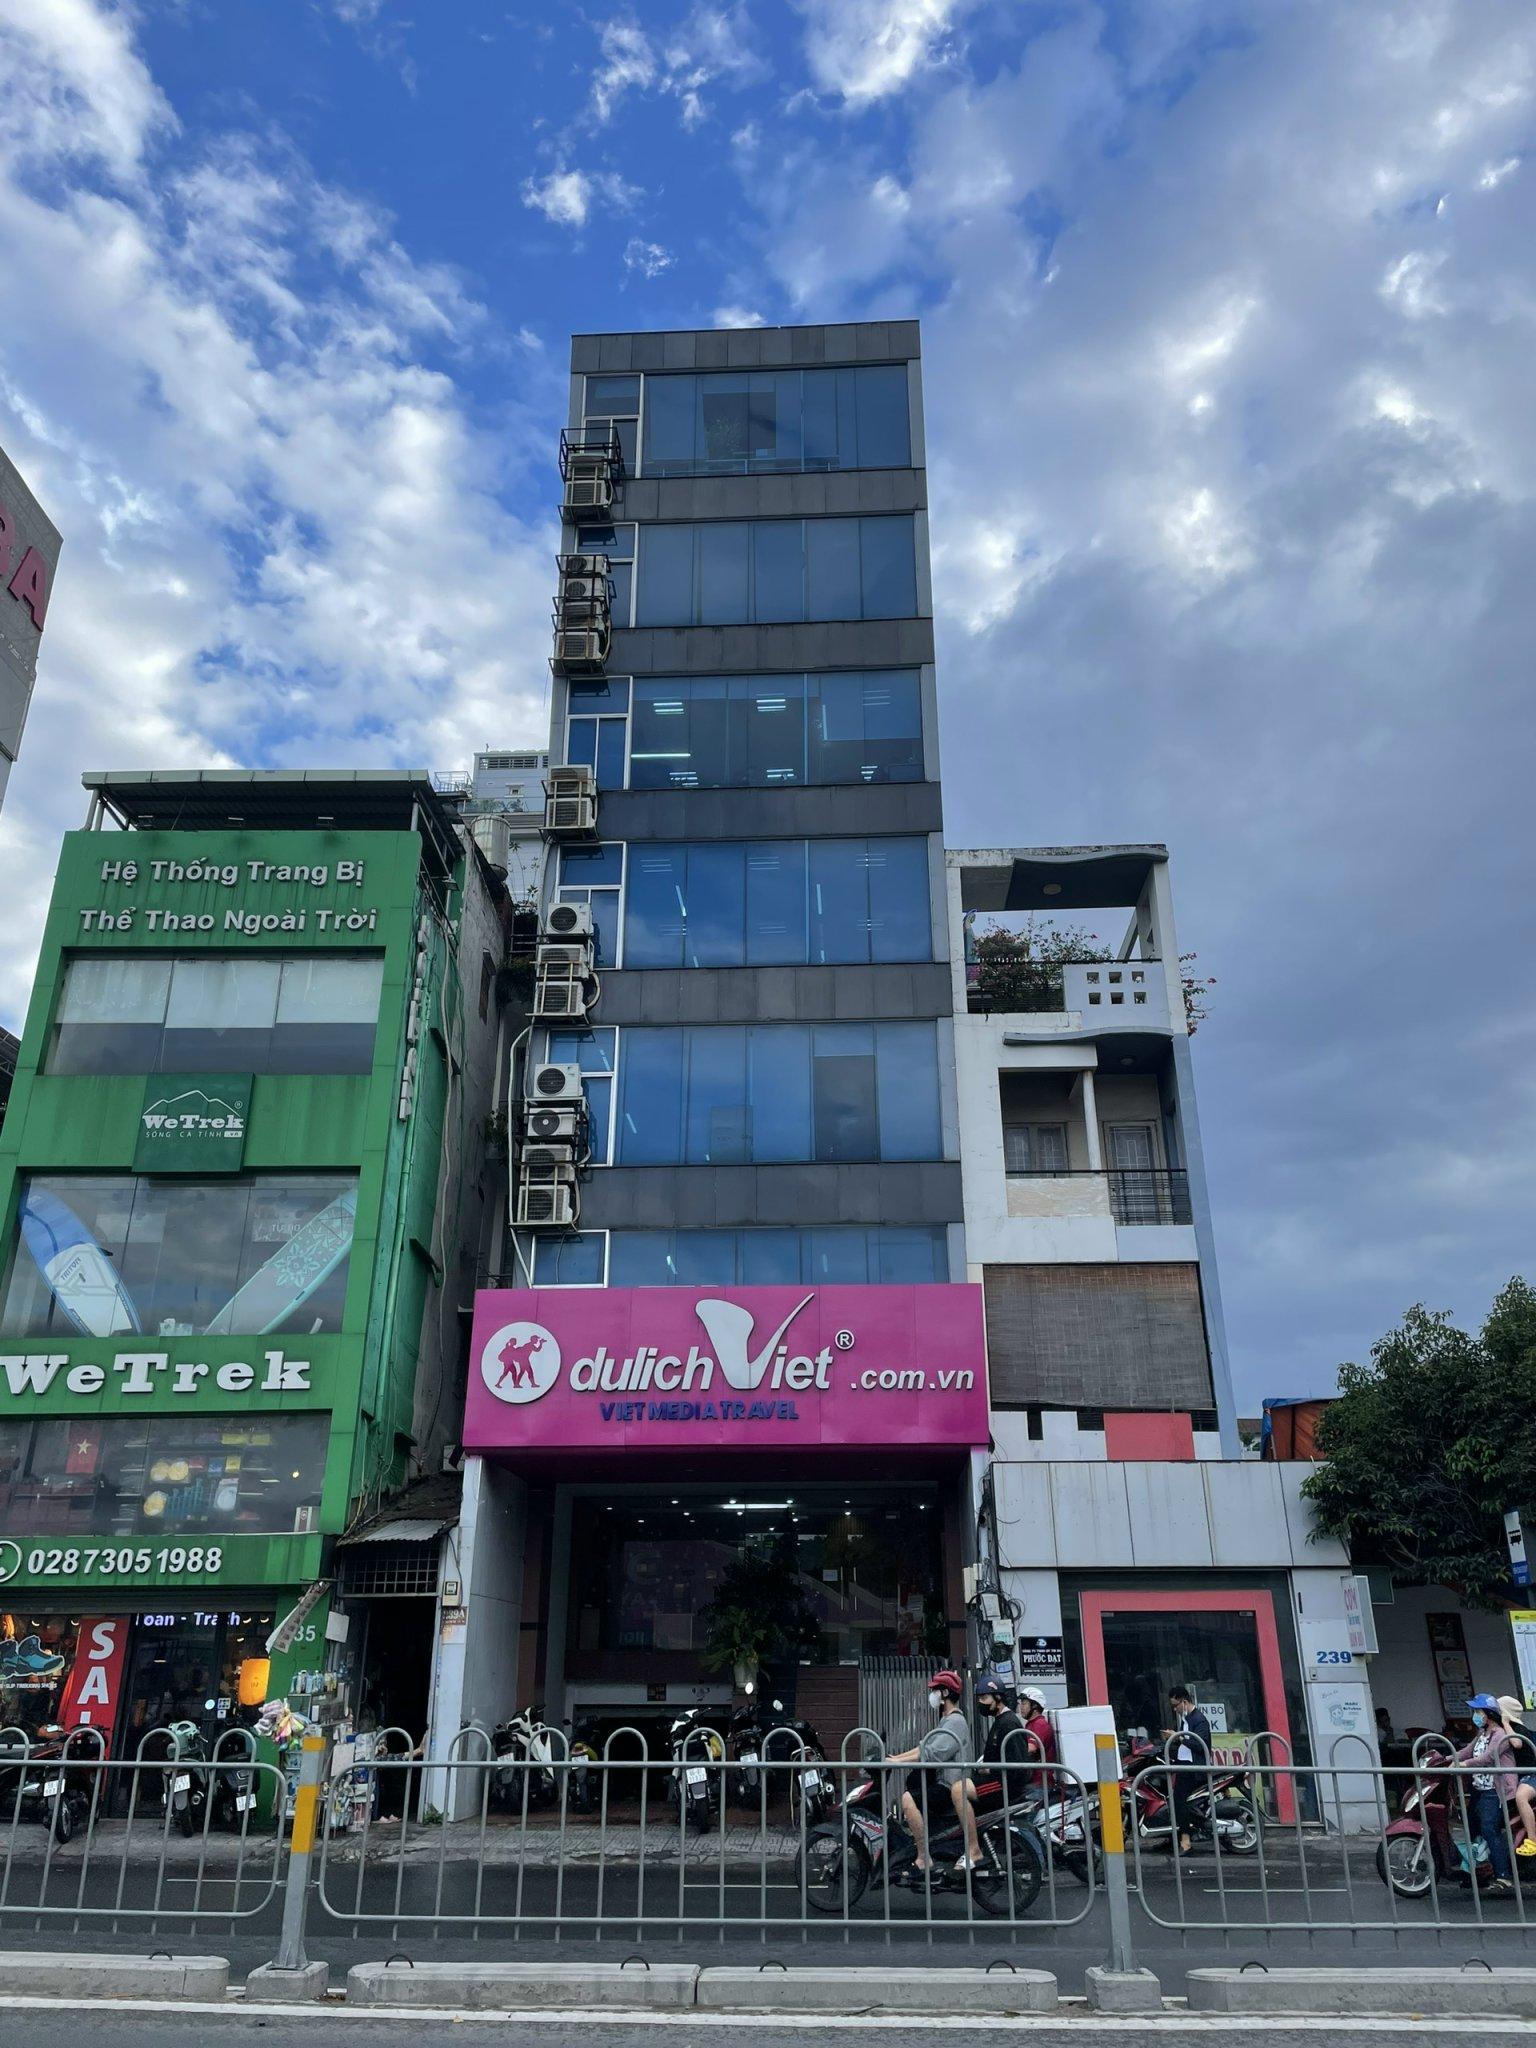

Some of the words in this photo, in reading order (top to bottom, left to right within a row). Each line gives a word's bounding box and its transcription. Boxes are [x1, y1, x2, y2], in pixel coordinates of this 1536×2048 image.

[101, 860, 138, 886] Hệ
[150, 857, 238, 886] Thống
[247, 861, 328, 886] Trang
[336, 861, 364, 887] Bị
[80, 906, 137, 930] Thể
[145, 910, 215, 931] Thao
[224, 908, 306, 935] Ngoài
[315, 908, 377, 930] Trời
[142, 1114, 244, 1129] WeTrek
[0, 1351, 311, 1395] WeTrek
[600, 1402, 646, 1421] VIET
[648, 1402, 718, 1421] MEDIA
[719, 1401, 799, 1420] TRAVEL
[27, 1547, 222, 1575] 02873051988
[1317, 1651, 1352, 1664] 239
